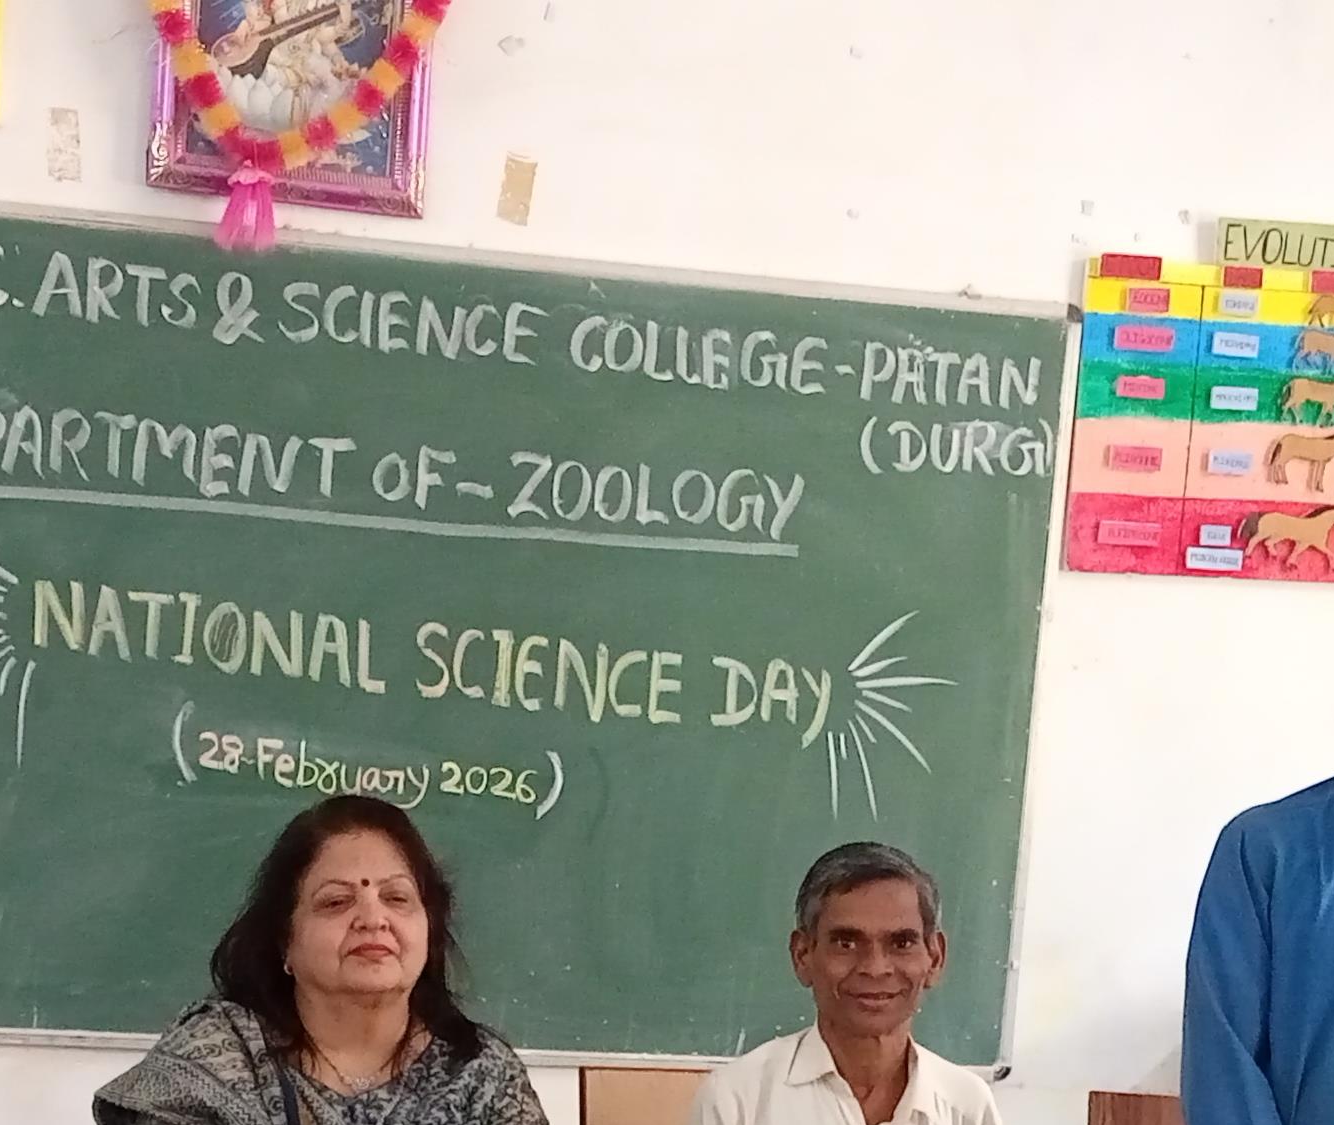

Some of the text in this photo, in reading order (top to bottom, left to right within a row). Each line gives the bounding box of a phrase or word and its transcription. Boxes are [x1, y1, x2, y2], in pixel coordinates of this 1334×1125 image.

[211, 270, 265, 346] &
[277, 281, 551, 366] SCIENCE
[859, 415, 1054, 478] (DURG)
[31, 577, 833, 748] NATIONAL SCIENCE DAY
